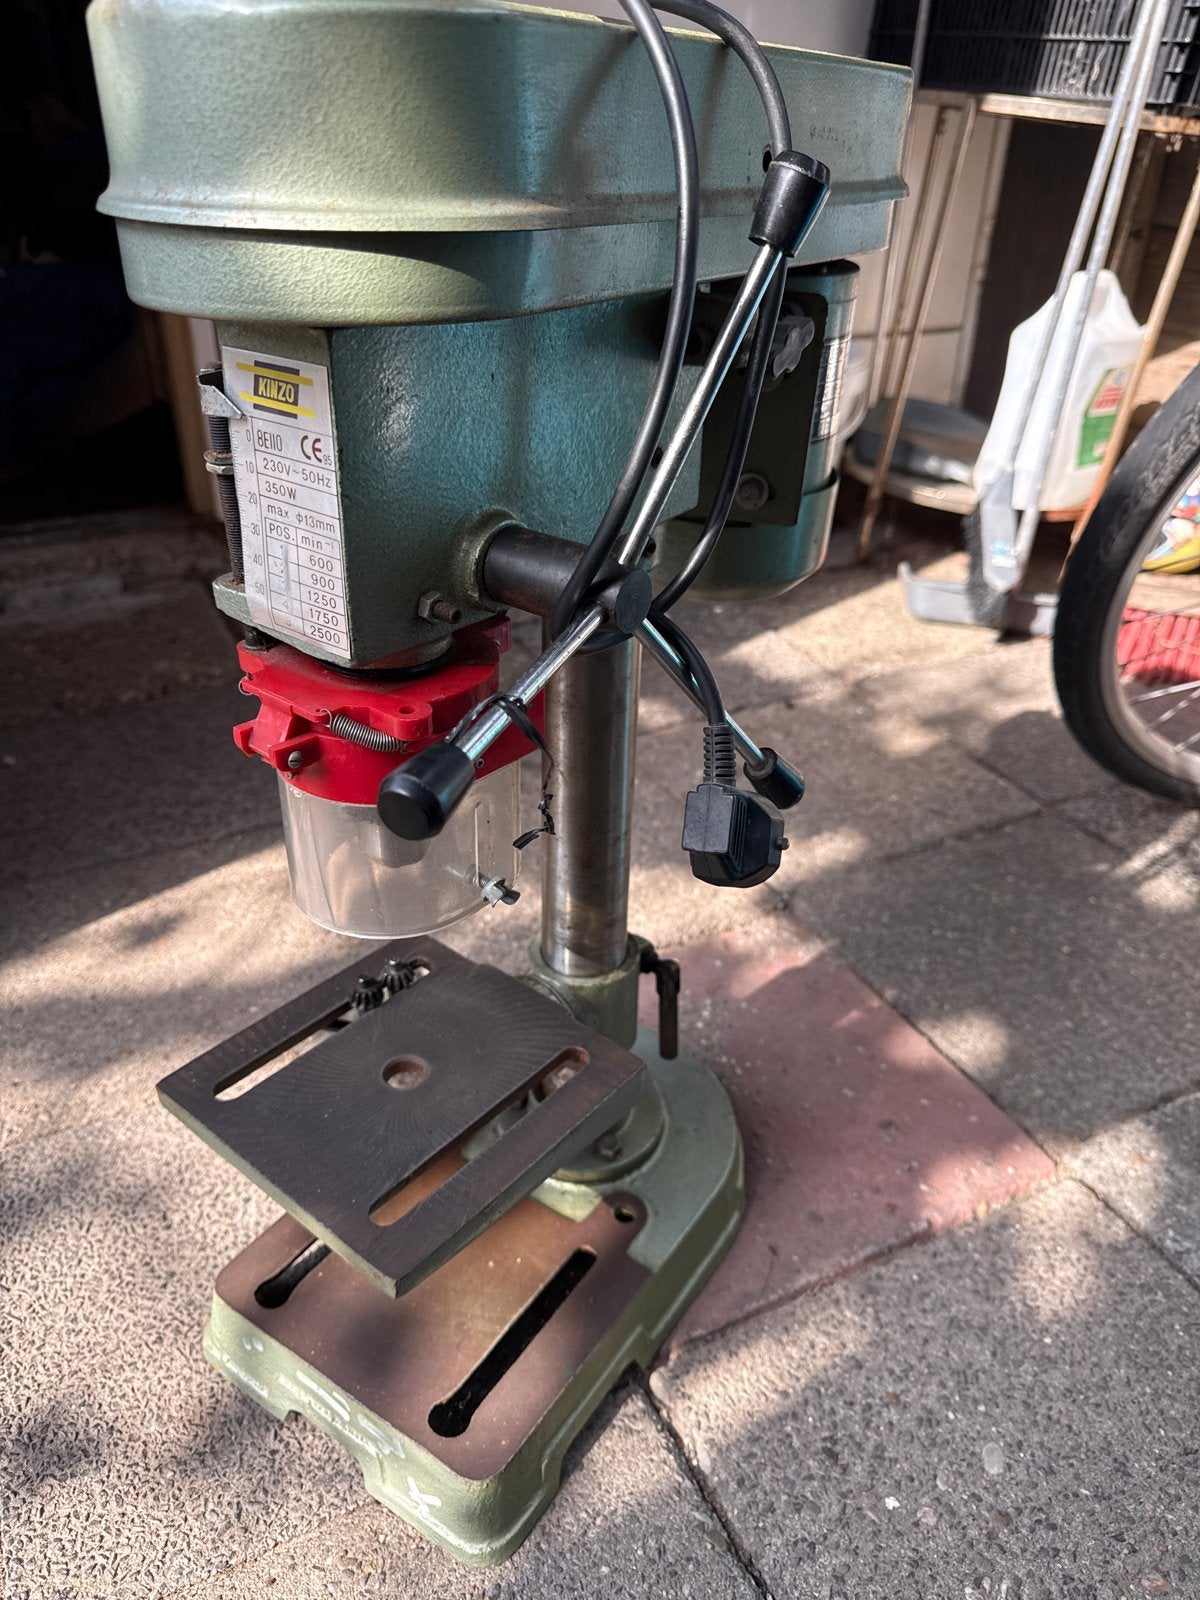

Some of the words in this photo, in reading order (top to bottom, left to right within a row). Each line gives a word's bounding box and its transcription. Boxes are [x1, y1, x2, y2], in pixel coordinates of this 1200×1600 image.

[258, 377, 295, 403] KINZO
[245, 429, 251, 442] 0
[245, 460, 254, 474] 10
[248, 491, 258, 505] 20
[265, 480, 296, 500] 350W
[267, 504, 290, 519] max
[251, 522, 260, 536] 30
[269, 522, 295, 541] POS.
[310, 554, 333, 572] 600
[311, 573, 335, 591] 900
[308, 590, 337, 609] 1250
[310, 608, 339, 627] 1750
[310, 625, 340, 644] 2500
